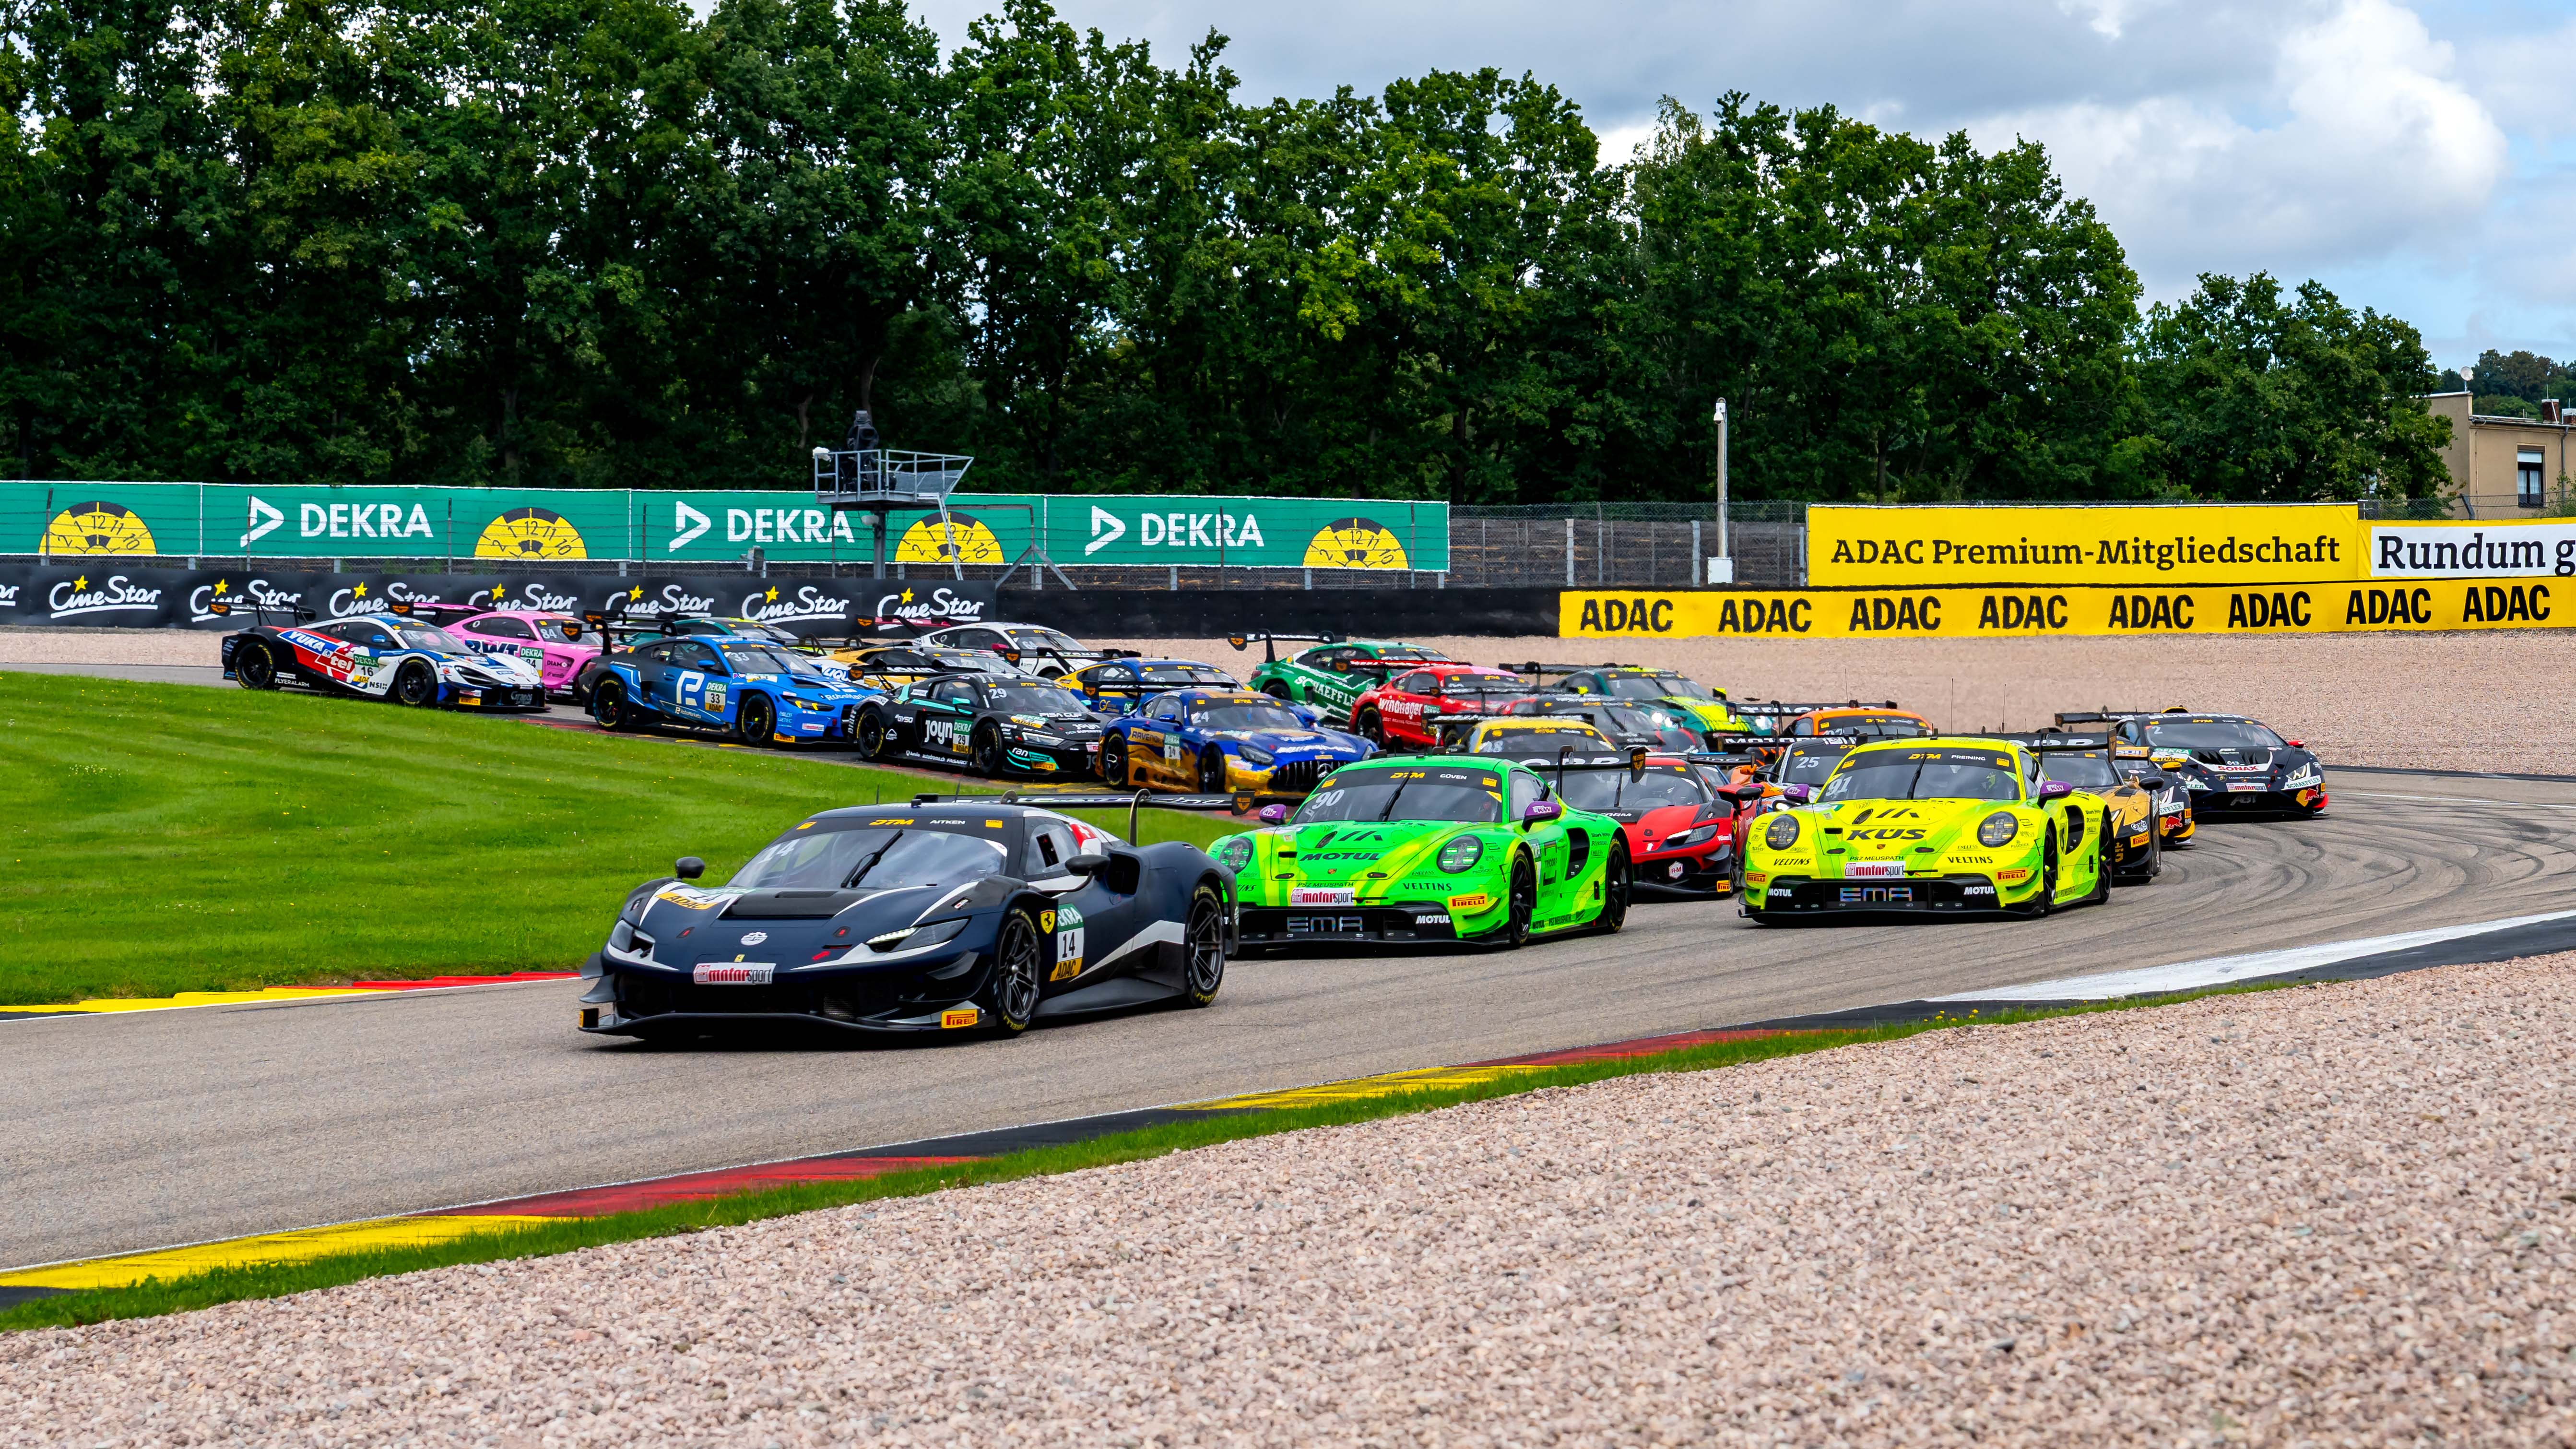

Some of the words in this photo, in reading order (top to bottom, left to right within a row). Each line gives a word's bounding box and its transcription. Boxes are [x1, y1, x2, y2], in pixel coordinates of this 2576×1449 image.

[301, 503, 434, 538] DEKRA
[727, 509, 855, 543] DEKRA
[91, 515, 106, 530] 12
[124, 534, 141, 550] 10
[1141, 512, 1265, 547] DEKRA
[525, 521, 539, 536] 12
[555, 537, 572, 555] 10
[1350, 530, 1364, 545] 12
[974, 543, 989, 559] 10
[1831, 539, 1924, 564] ADAC
[1933, 534, 2340, 571] Premium-Mitgliedschaft
[2378, 533, 2546, 570] Rundum
[49, 575, 162, 612] CineStar
[742, 586, 850, 620] CineStar
[877, 588, 984, 619] CineStar
[2228, 591, 2311, 628] ADAC
[2345, 588, 2431, 625] ADAC
[2462, 583, 2551, 622] ADAC
[1580, 598, 1673, 633] ADAC
[1718, 598, 1812, 633] ADAC
[1849, 595, 1941, 631] ADAC
[1978, 595, 2068, 629] ADAC
[2109, 594, 2194, 629] ADAC
[288, 631, 325, 651] YUKA
[540, 628, 557, 639] 84
[354, 655, 378, 665] DEKRA
[521, 648, 543, 657] DEKRA
[730, 652, 750, 661] 33
[330, 655, 353, 671] tel
[361, 666, 374, 677] 16
[822, 667, 851, 682] LIQU
[274, 678, 310, 688] FLYERALARM
[706, 682, 726, 692] DEKRA
[710, 693, 721, 703] 33
[989, 688, 1007, 699] 29
[1294, 676, 1356, 707] SCHAEFFLE
[924, 720, 953, 744] joyn
[954, 722, 971, 732] DEKRA
[2152, 726, 2163, 734] 2
[957, 735, 966, 745] 29
[1012, 747, 1028, 757] ran
[1796, 756, 1820, 769] 25
[1826, 776, 1853, 796] 91
[2286, 778, 2321, 789] SCHAEFFLER
[1312, 789, 1345, 810] 90
[2160, 804, 2183, 814] EFFLER
[1847, 828, 1927, 840] KÜS
[2133, 834, 2149, 844] PIRELLI
[1299, 852, 1381, 862] MOTUL
[1773, 857, 1812, 866] VELTINS
[1747, 873, 1765, 882] PIRELLI
[1855, 864, 1905, 877] motorsport
[1997, 869, 2026, 880] PIRELLI
[1237, 884, 1257, 892] TINS
[1403, 882, 1453, 891] VELTINS
[1767, 888, 1792, 897] MOTUL
[1963, 886, 1995, 895] MOTUL
[1302, 890, 1354, 905] motorsport
[1452, 895, 1485, 908] PIRELLI
[1840, 887, 1912, 902] EMA
[666, 895, 708, 910] ADAC
[1058, 907, 1083, 926] EKRA
[1287, 916, 1363, 932] EMA
[1416, 915, 1451, 925] MOTUL
[1062, 931, 1076, 959] 14
[708, 968, 773, 984] motorsport
[1056, 961, 1077, 980] ADAC
[947, 1013, 976, 1026] PIRELLI
